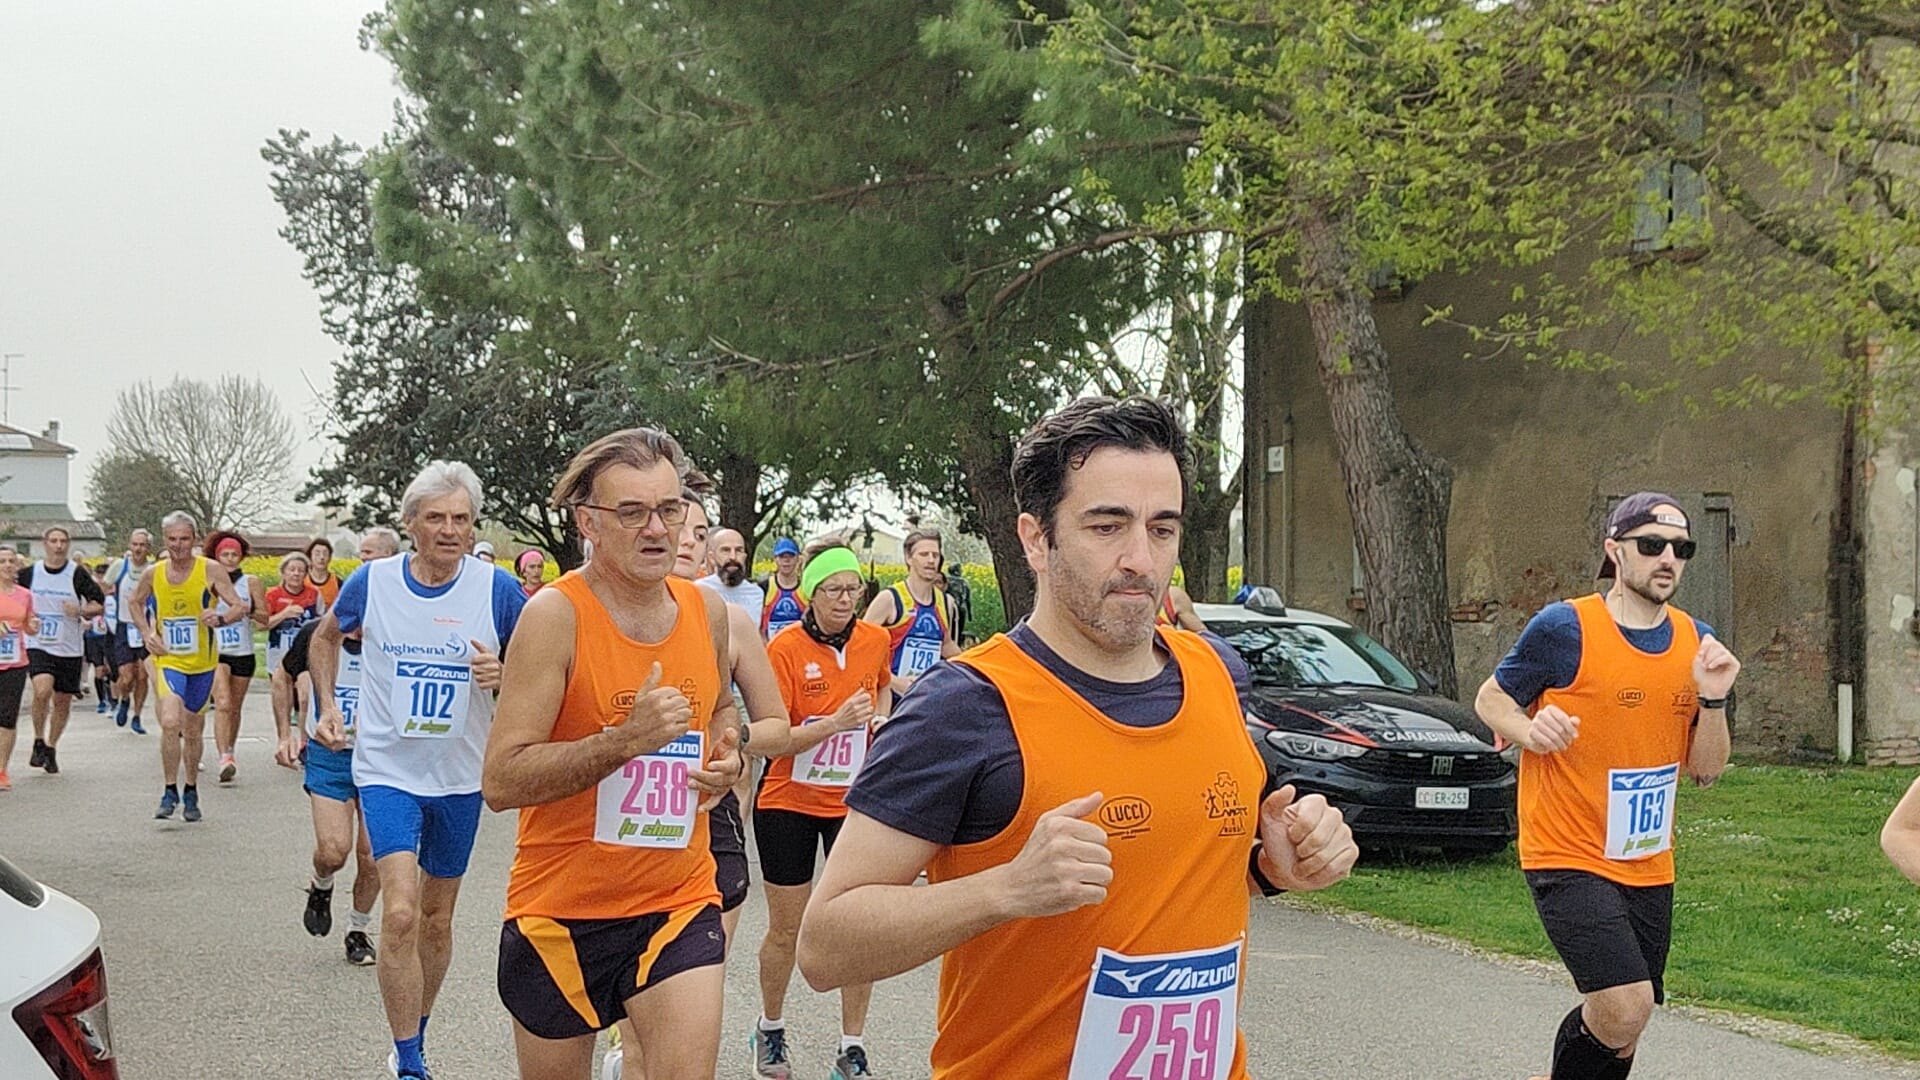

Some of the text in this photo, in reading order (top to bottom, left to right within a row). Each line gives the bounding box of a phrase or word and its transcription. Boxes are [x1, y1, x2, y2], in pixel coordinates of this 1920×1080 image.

[169, 626, 191, 644] 103
[221, 627, 240, 644] 135
[911, 649, 934, 670] 128
[410, 680, 456, 719] 102
[1383, 730, 1482, 744] CARABINIERI
[812, 733, 854, 767] 215
[1431, 755, 1455, 776] FIAT
[620, 759, 690, 817] 238
[1106, 802, 1145, 823] LUCCI
[1628, 788, 1666, 836] 163
[1108, 998, 1221, 1080] 259
